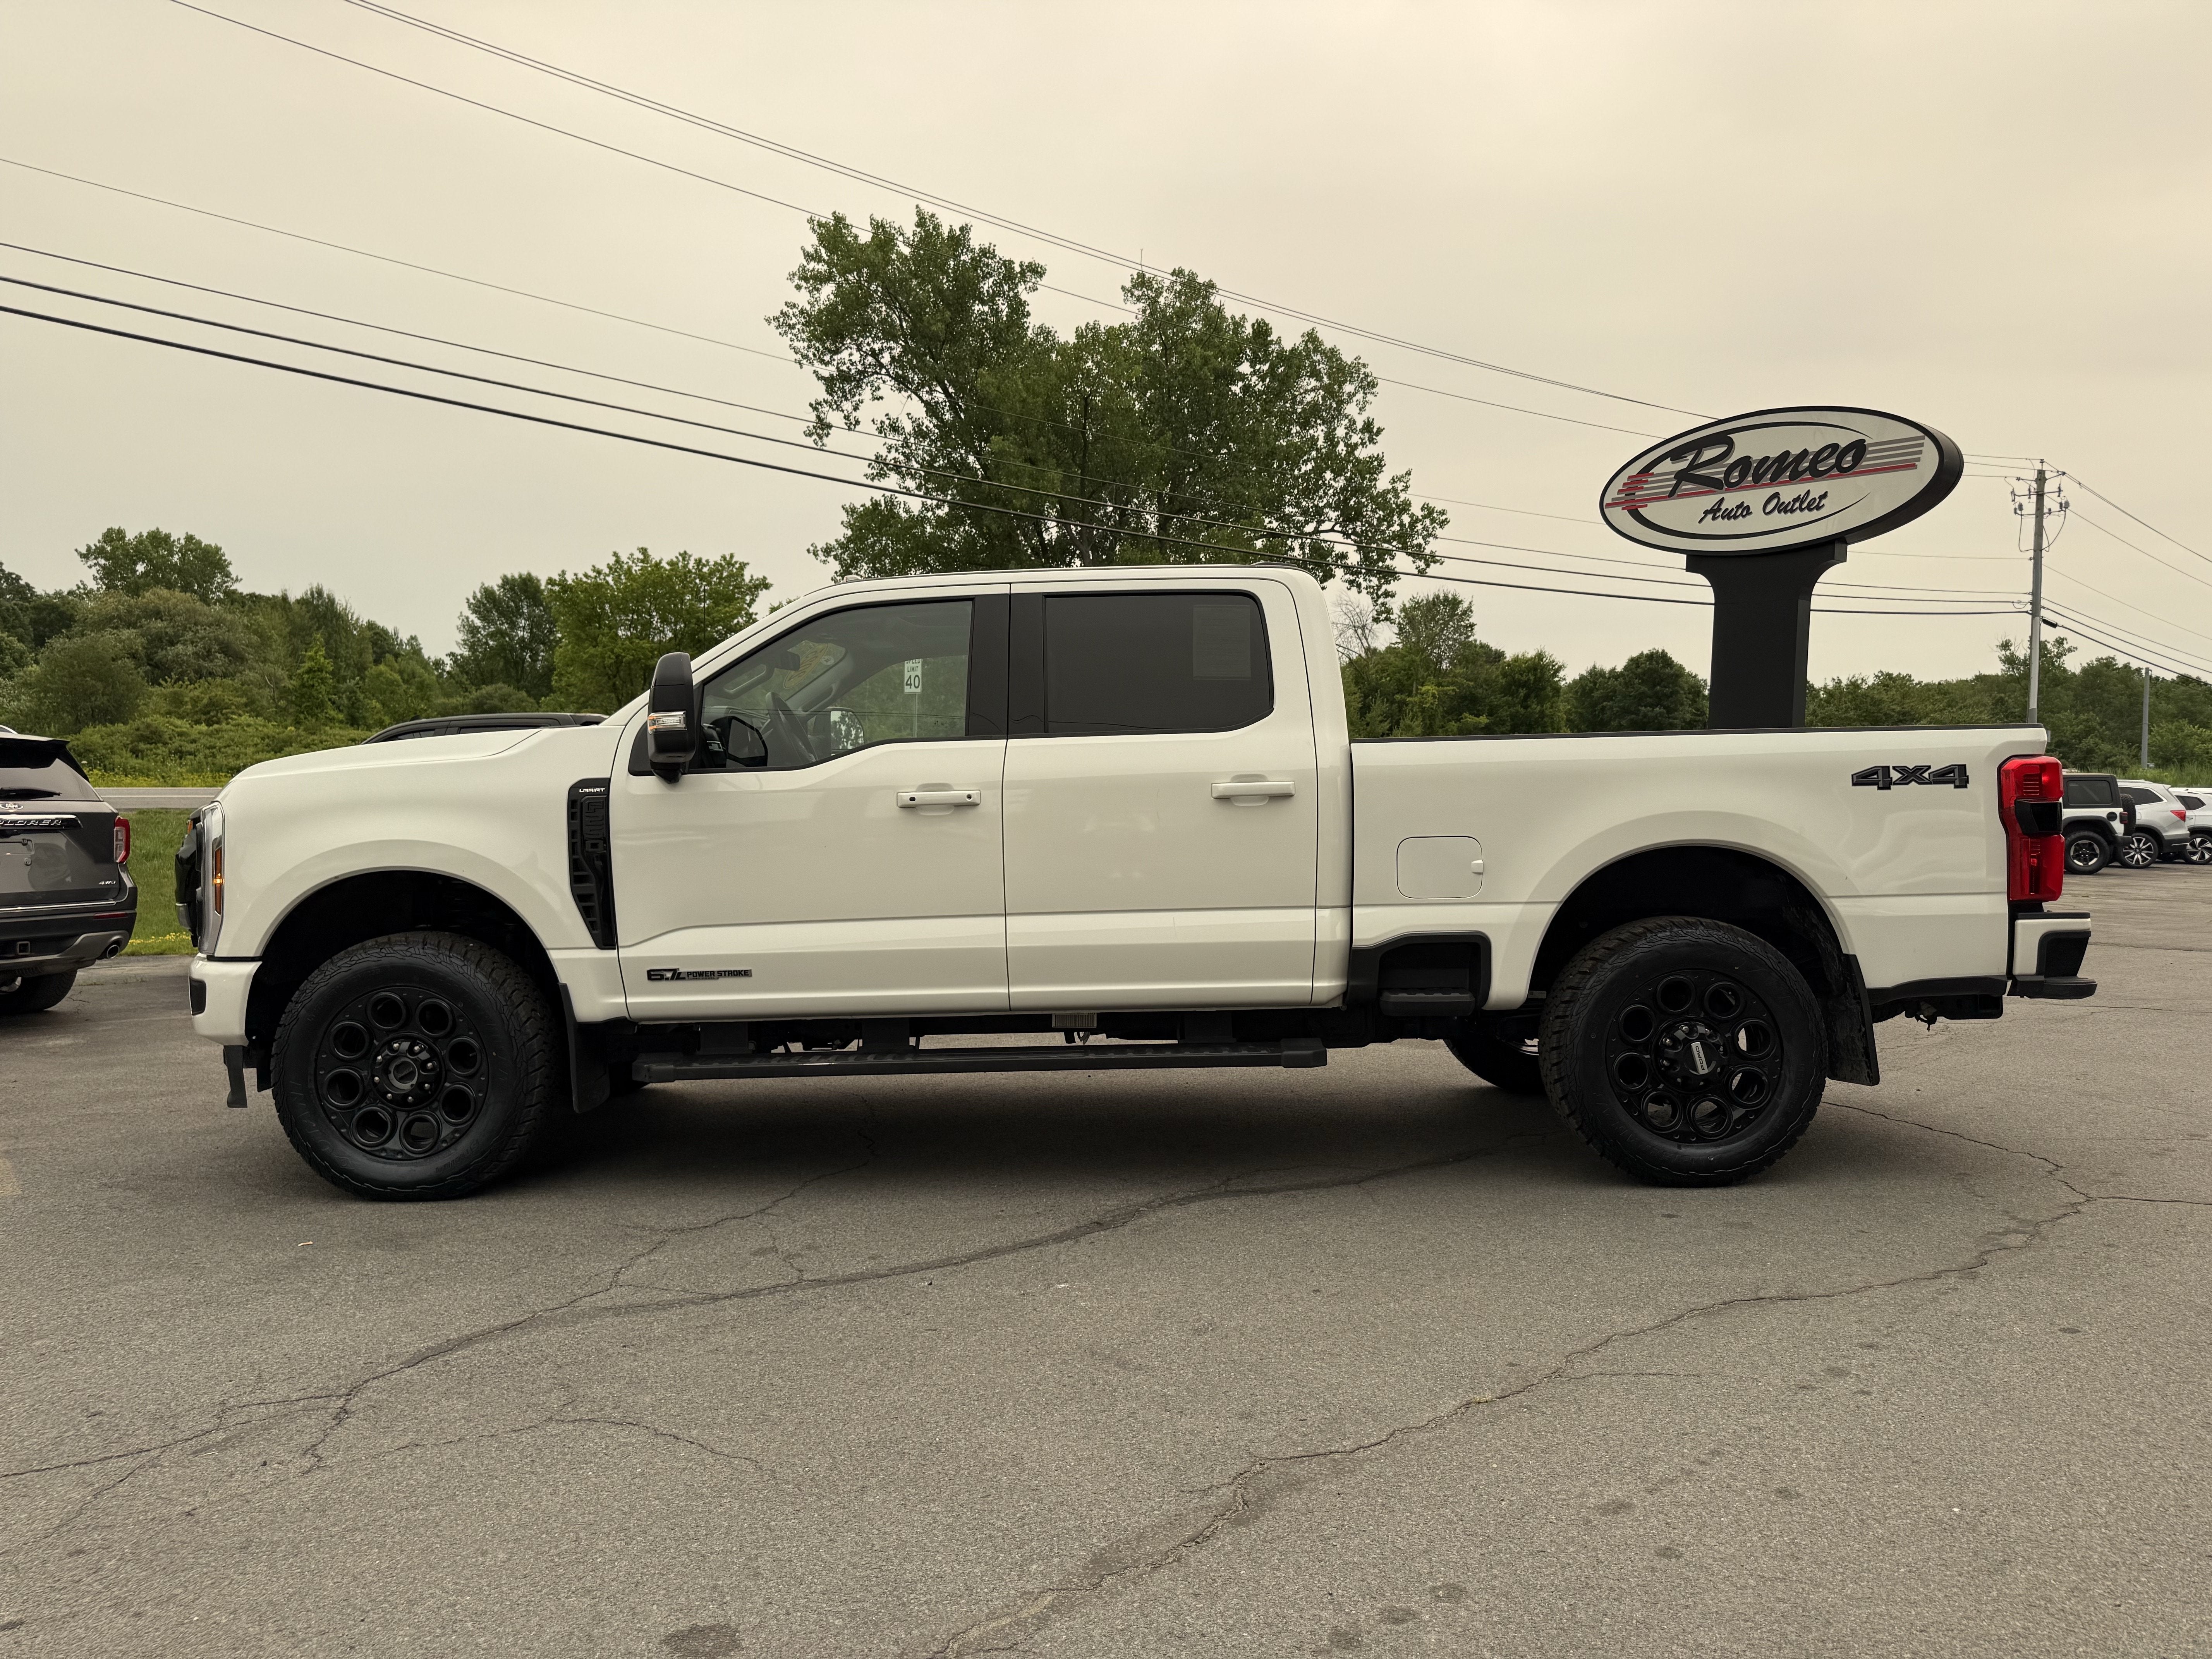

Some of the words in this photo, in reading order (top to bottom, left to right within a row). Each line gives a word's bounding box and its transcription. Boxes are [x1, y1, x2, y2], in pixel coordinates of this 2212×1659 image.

[1668, 434, 1869, 498] Romeo
[1698, 497, 1752, 524] Auto
[1762, 489, 1827, 517] Outlet
[905, 675, 920, 689] 40
[646, 968, 686, 980] 6.7L
[1695, 1046, 1705, 1070] FORD
